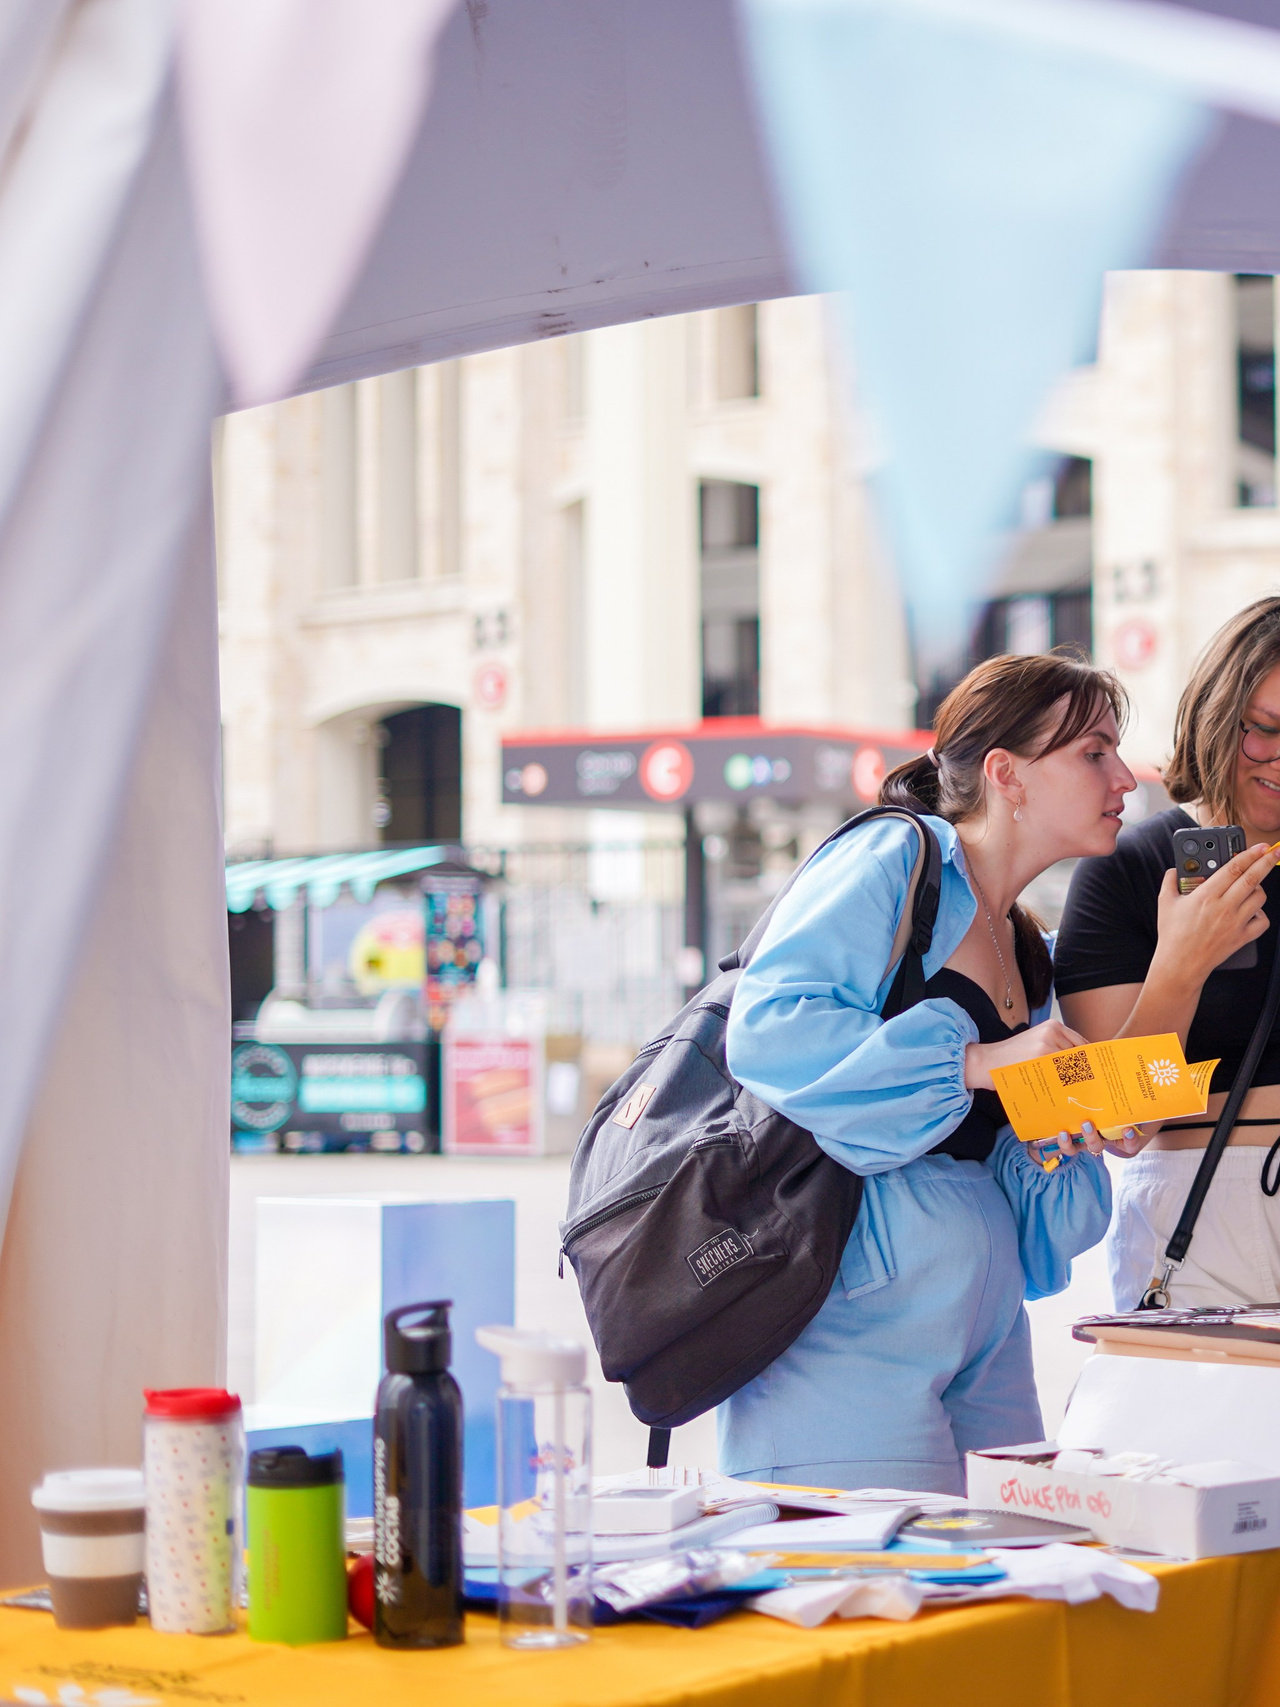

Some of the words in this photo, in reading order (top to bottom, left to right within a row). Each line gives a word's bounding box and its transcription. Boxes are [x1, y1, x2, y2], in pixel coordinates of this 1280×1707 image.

[695, 1237, 739, 1275] SKECHERS
[708, 1255, 739, 1278] ORIGINAL
[385, 1495, 400, 1566] СОСТАВ
